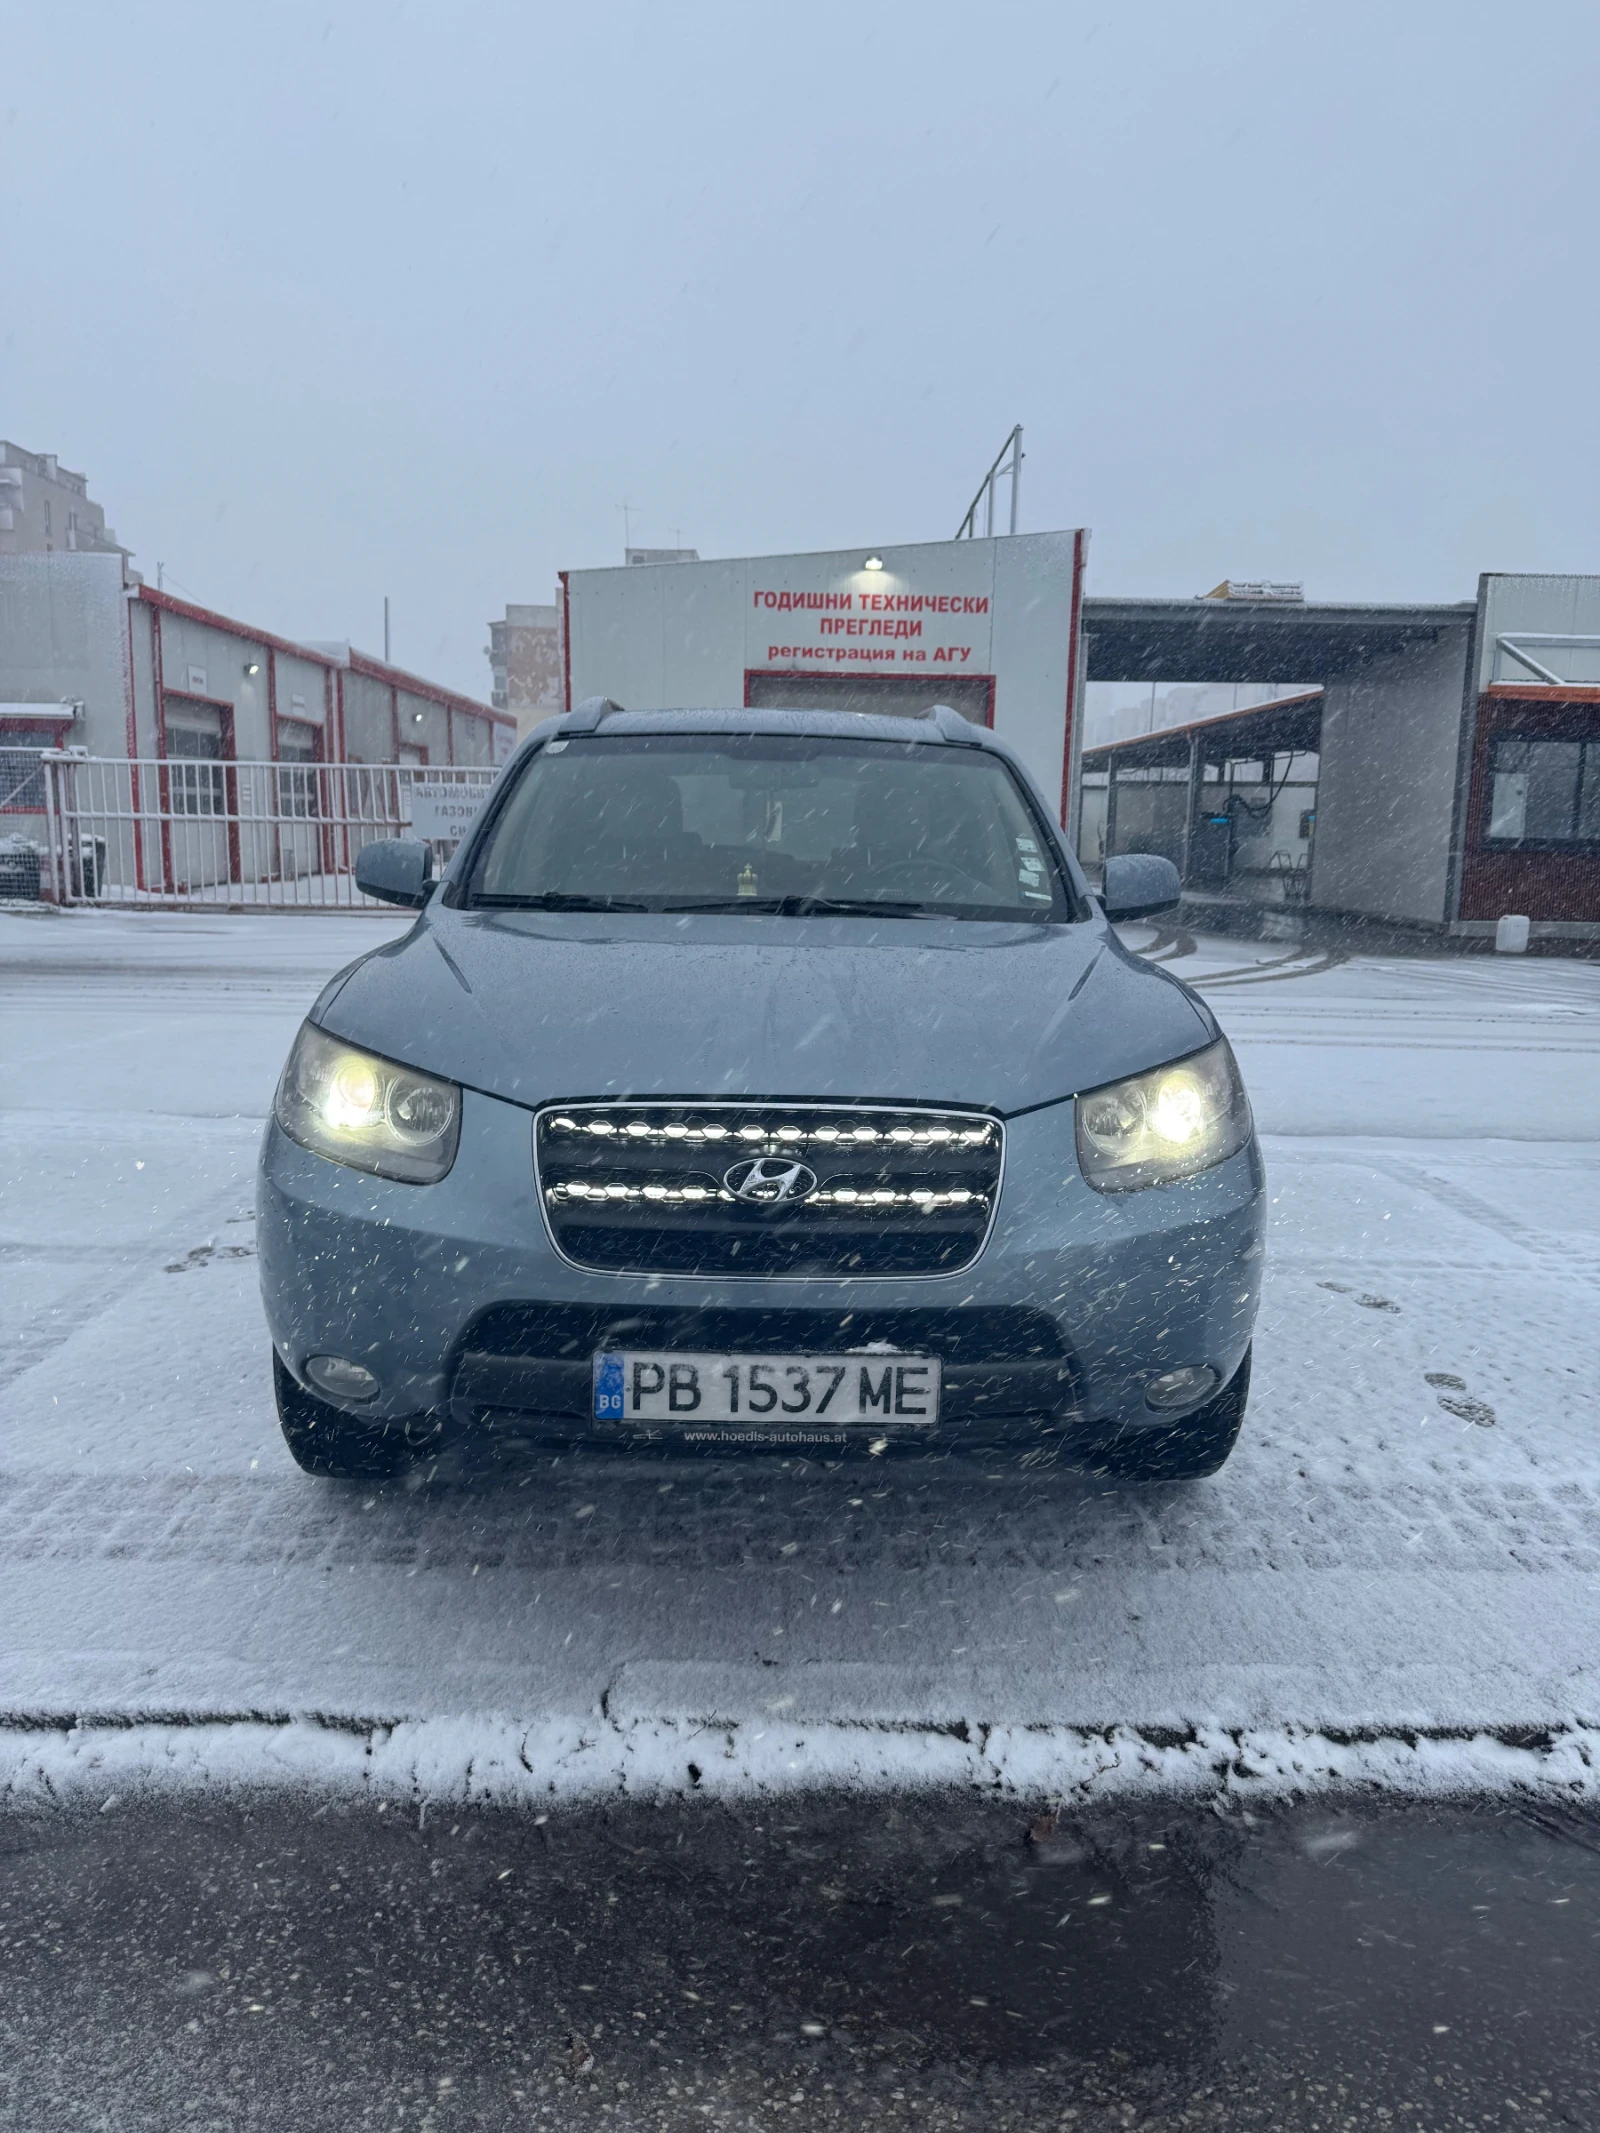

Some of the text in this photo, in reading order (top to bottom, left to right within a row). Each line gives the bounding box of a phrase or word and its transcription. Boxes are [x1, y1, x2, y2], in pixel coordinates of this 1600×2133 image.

[753, 591, 989, 614] ГОДИШНИ ТЕХНИЧЕСКИ
[820, 618, 922, 639] ПРЕГЛЕДИ
[768, 646, 972, 662] регистрация на АГУ
[599, 1362, 929, 1415] BG PB 1537 ME
[684, 1430, 847, 1443] www.hoedls-autohaus.at
